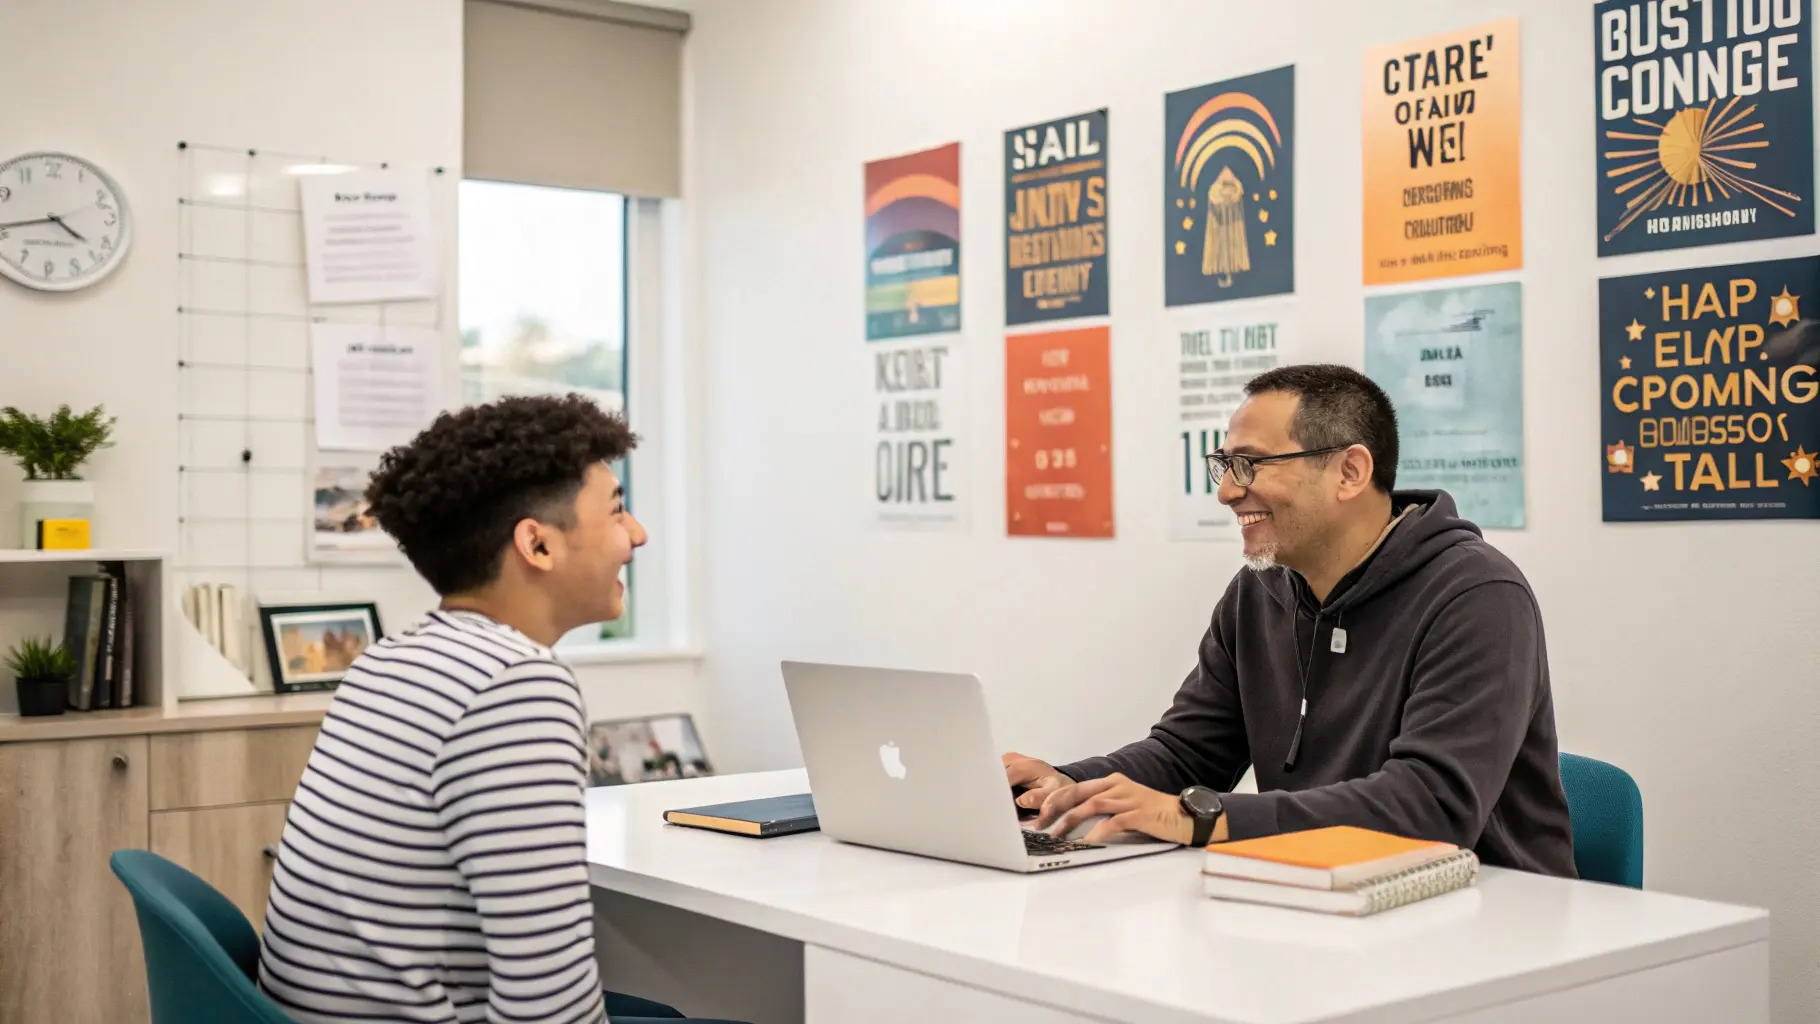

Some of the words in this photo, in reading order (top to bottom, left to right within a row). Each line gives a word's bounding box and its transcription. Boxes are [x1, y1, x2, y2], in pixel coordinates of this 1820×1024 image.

[1602, 33, 1799, 120] CONNGE
[1661, 278, 1758, 322] HAP
[1612, 364, 1819, 413] CPOMNG
[1663, 452, 1780, 492] TALL
